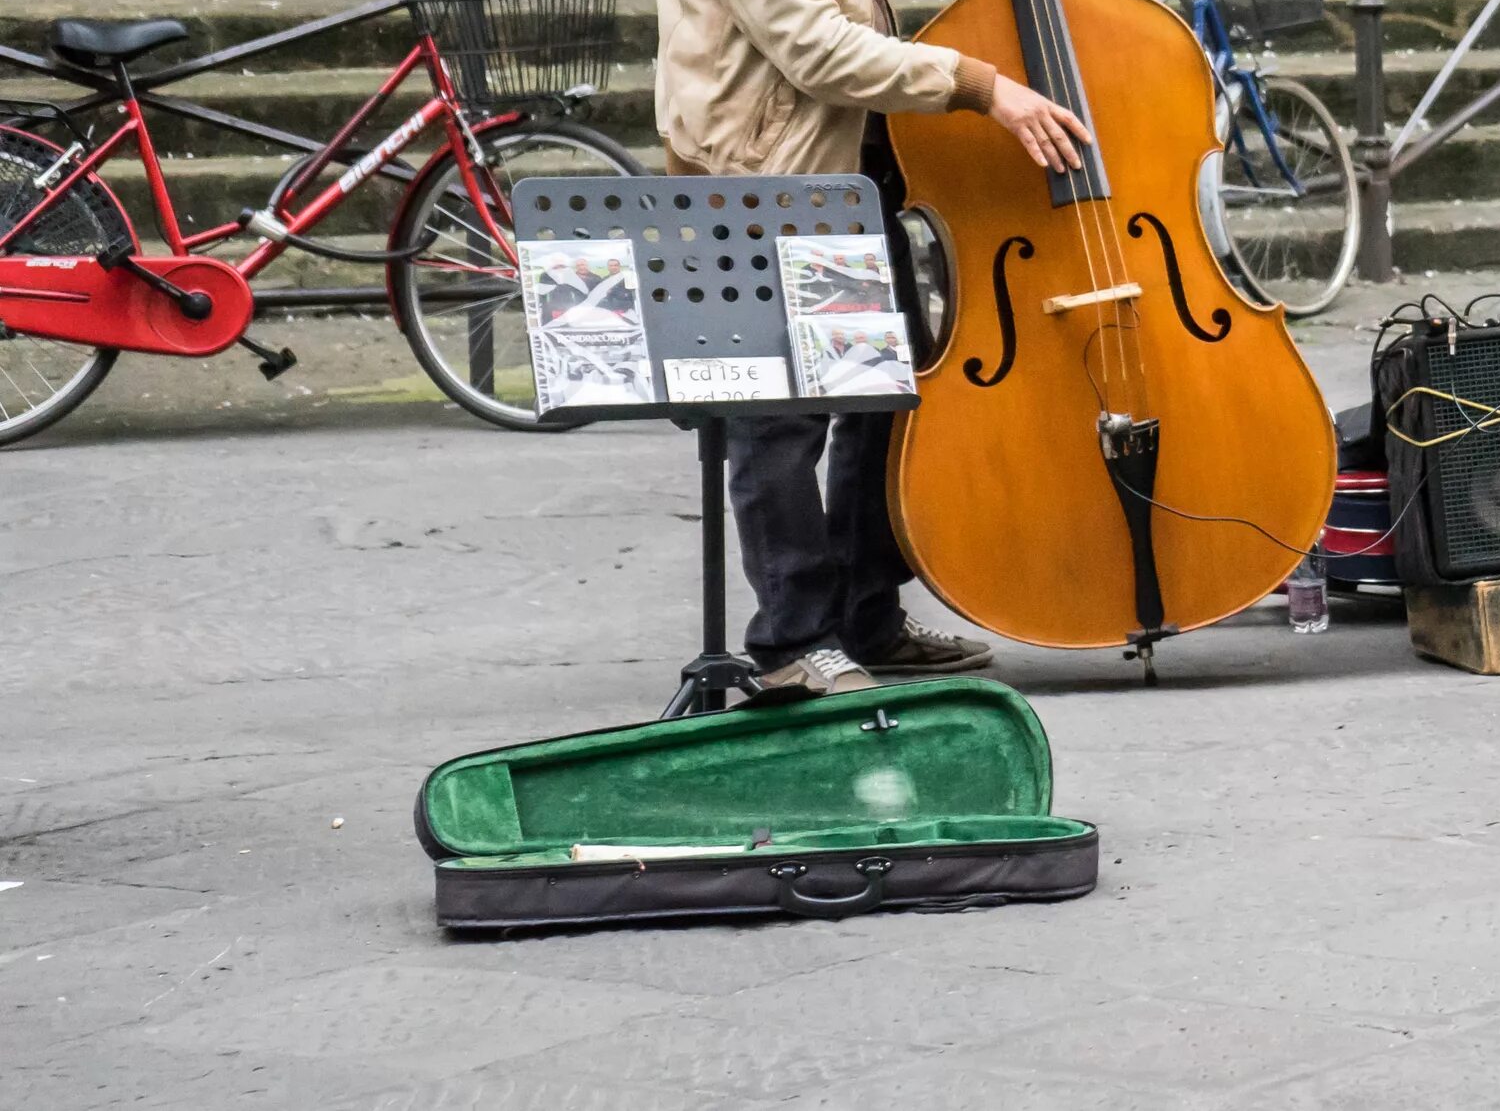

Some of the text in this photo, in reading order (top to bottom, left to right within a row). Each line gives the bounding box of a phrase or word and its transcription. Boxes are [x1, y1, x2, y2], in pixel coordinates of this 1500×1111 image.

[673, 365, 760, 381] 1 cd 15 €
